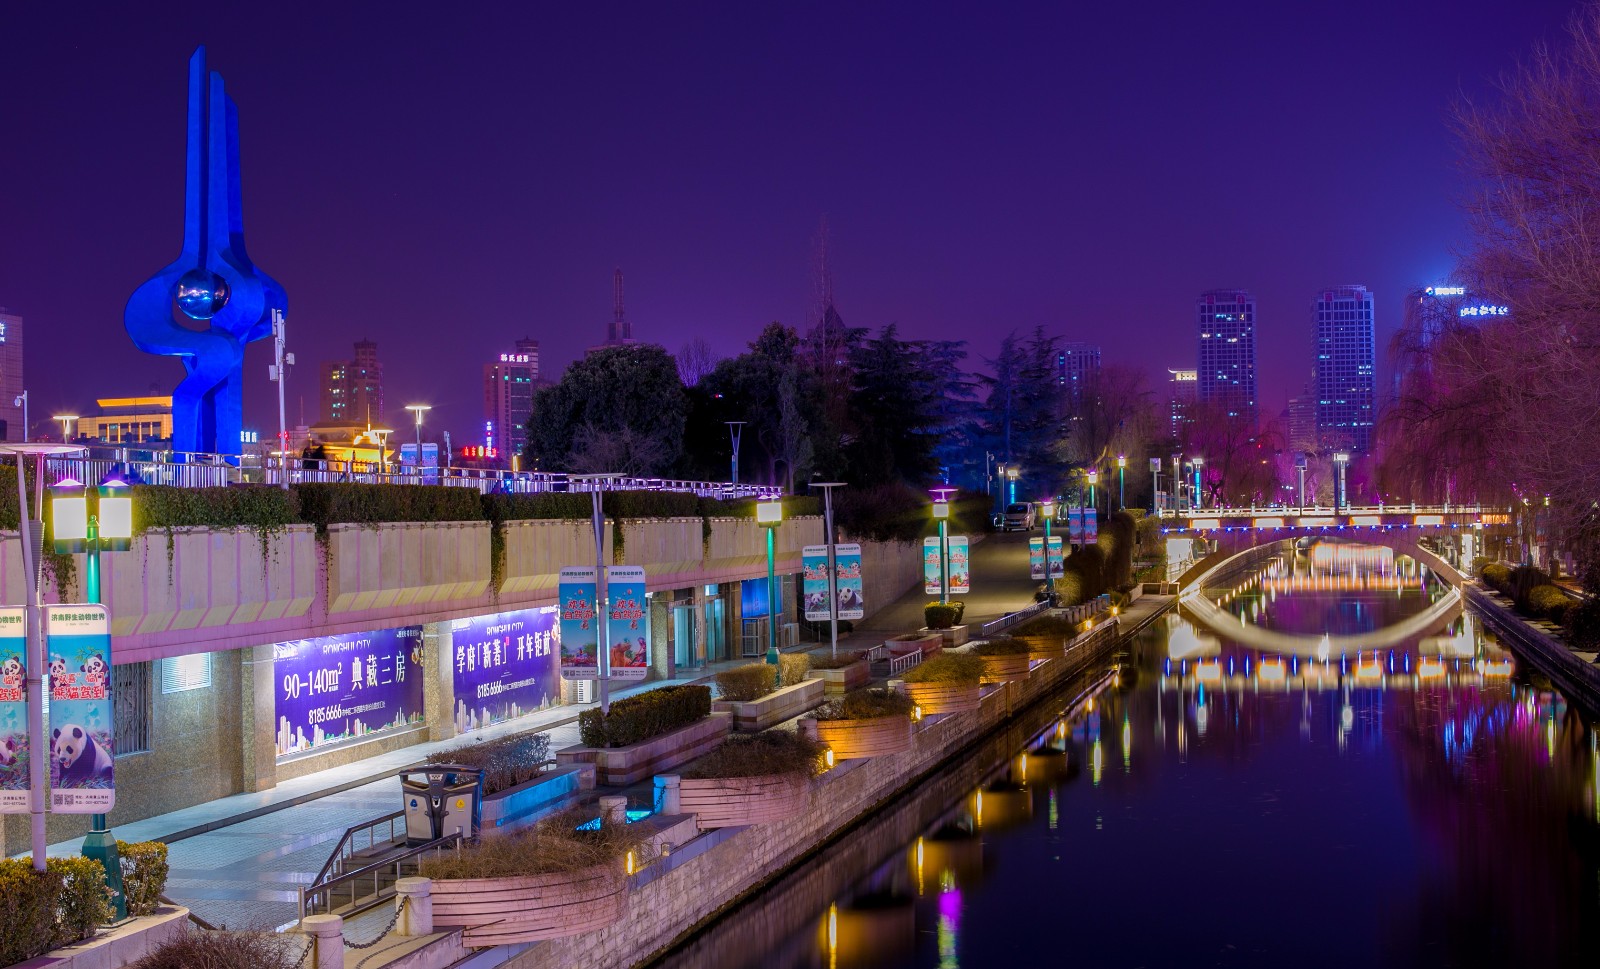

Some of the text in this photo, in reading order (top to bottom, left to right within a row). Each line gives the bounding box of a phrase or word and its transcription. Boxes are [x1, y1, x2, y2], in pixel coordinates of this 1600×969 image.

[51, 612, 105, 621] 济南野生动物世界
[351, 650, 406, 691] 典藏三房
[86, 672, 105, 683] 临门
[53, 686, 105, 700] 熊猫驾到
